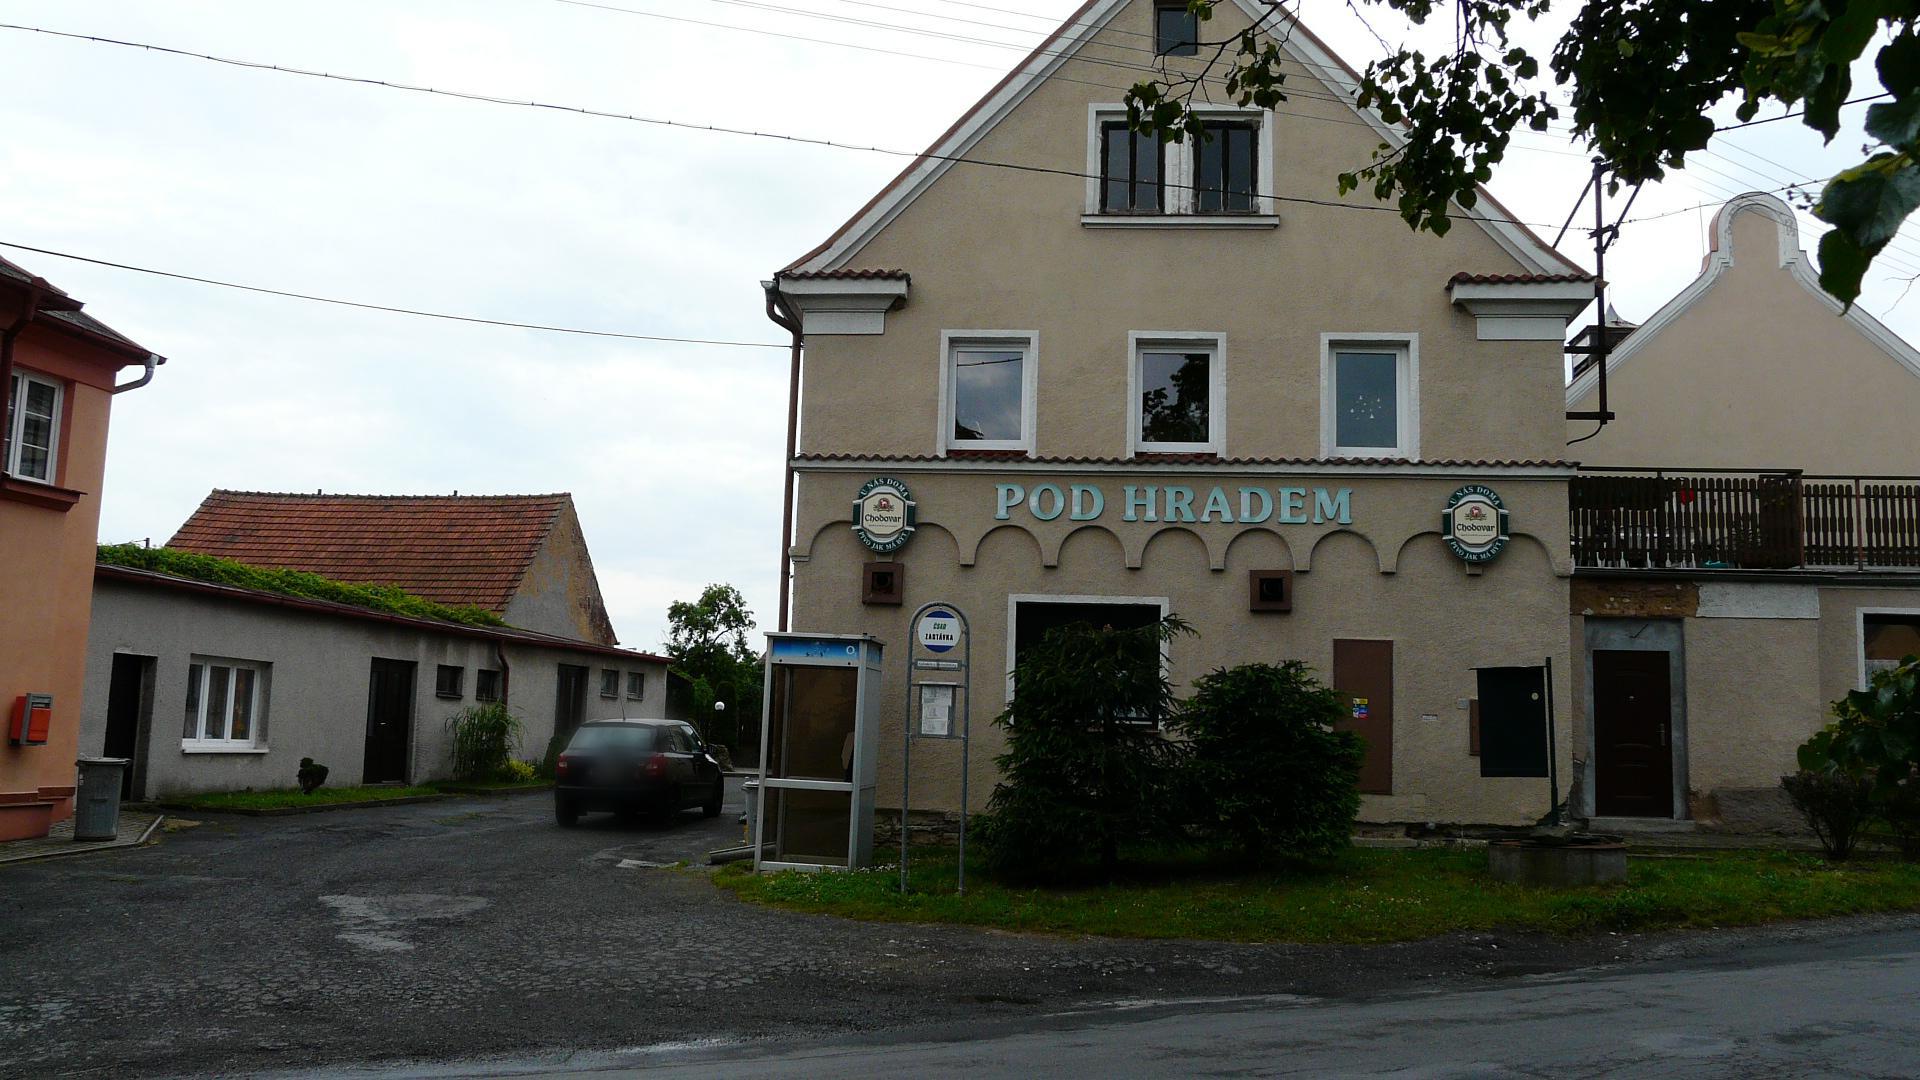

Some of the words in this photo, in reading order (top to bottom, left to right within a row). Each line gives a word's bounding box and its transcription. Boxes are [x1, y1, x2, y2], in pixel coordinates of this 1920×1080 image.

[887, 479, 908, 497] DOMA
[1476, 487, 1500, 505] DOMA
[994, 482, 1105, 522] POD
[1122, 485, 1353, 525] HRADEM
[865, 514, 902, 523] Chobovar
[1456, 523, 1496, 533] Chobovar
[871, 543, 884, 551] JAK
